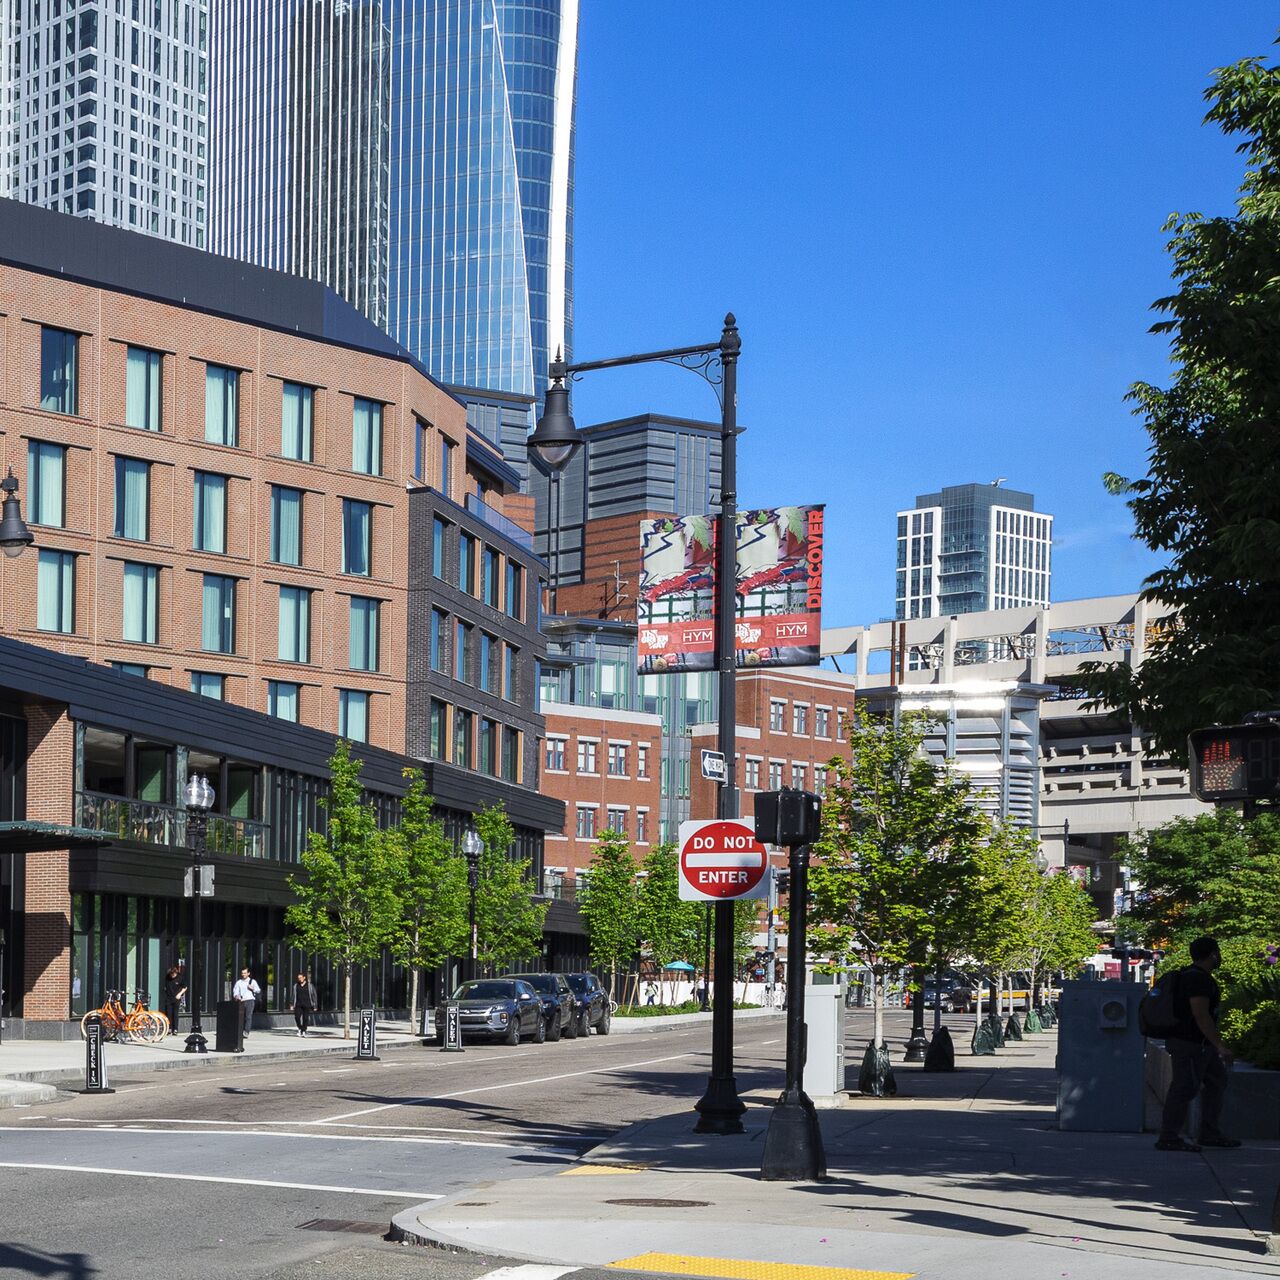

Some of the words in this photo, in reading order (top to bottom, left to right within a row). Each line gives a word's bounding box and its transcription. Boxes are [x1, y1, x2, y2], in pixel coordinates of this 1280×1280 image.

[806, 510, 823, 609] DISCOVER
[682, 630, 713, 643] HYM
[776, 624, 808, 637] HYM
[693, 836, 715, 850] DO
[724, 836, 755, 849] NOT
[698, 870, 748, 884] ENTER
